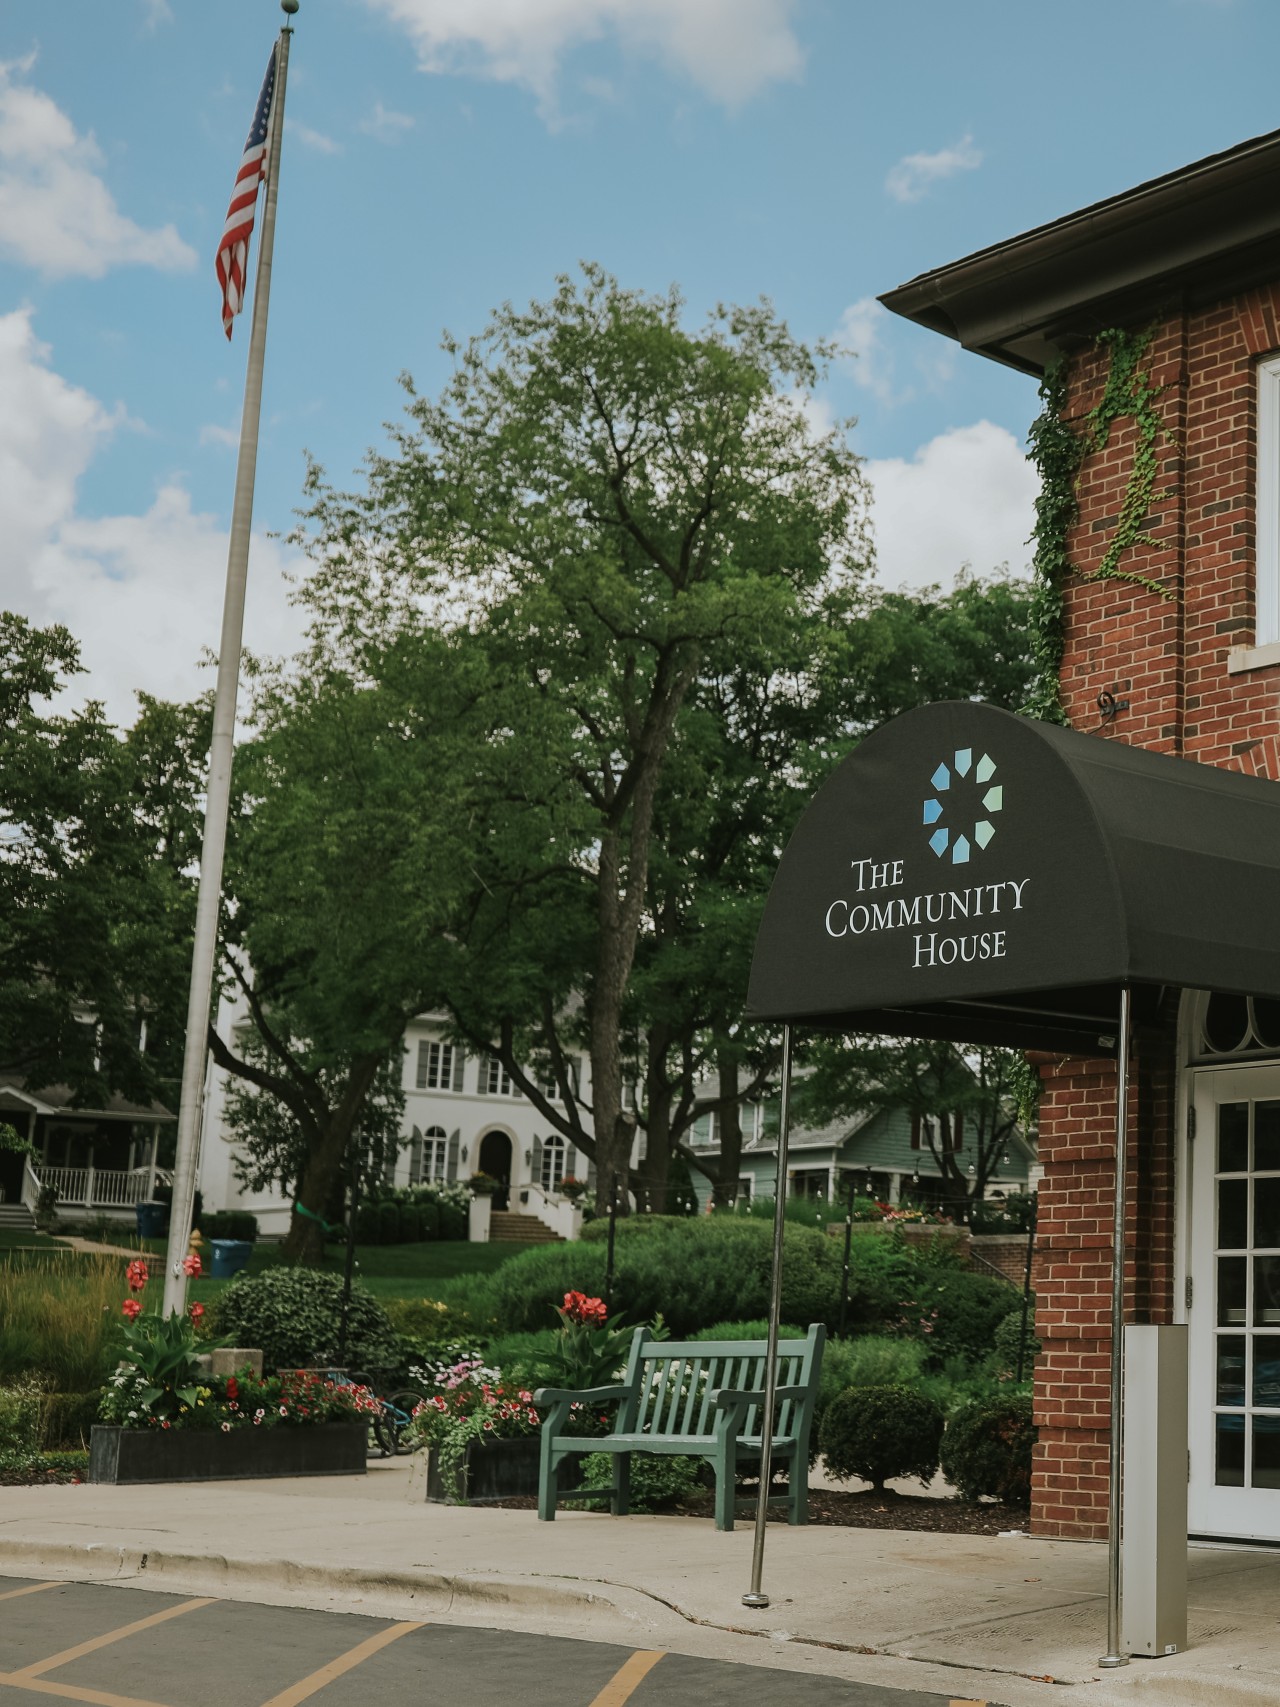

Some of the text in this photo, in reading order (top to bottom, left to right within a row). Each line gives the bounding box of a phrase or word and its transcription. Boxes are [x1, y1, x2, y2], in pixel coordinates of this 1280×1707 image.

[851, 857, 904, 892] THE
[825, 878, 1031, 938] COMMUNITY
[912, 930, 1007, 968] HOUSE
